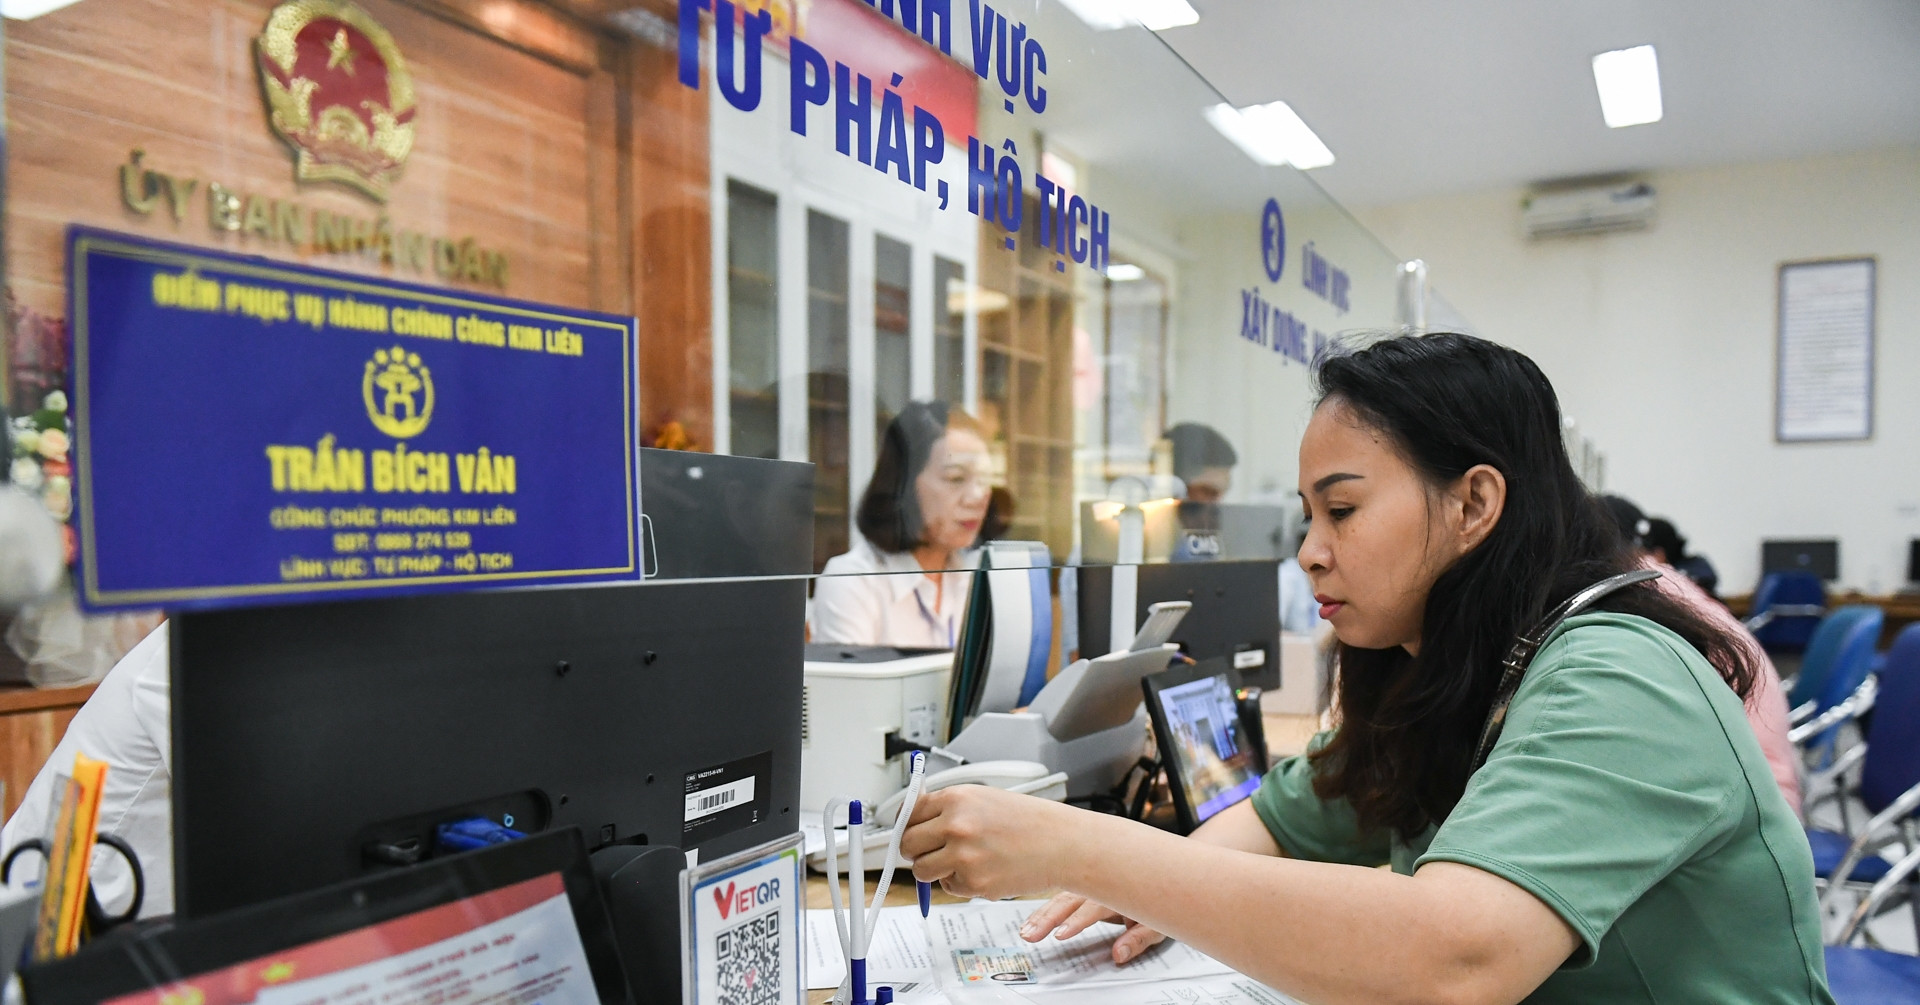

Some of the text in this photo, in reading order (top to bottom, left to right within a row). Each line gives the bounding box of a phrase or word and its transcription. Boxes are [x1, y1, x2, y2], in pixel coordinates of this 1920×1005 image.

[969, 0, 1047, 114] VỰC
[678, 0, 772, 112] TƯ
[790, 36, 949, 210] PHÁP,
[968, 135, 1023, 251] HỘ
[1036, 173, 1110, 274] TỊCH
[208, 181, 302, 245] BAN
[312, 208, 431, 273] NHÂN
[433, 236, 510, 289] DÂN
[225, 282, 290, 325] PHỤC
[294, 293, 326, 331] VỤ
[391, 306, 453, 340] CHÍNH
[456, 314, 506, 347] CÔNG
[508, 324, 542, 351] KIM
[545, 327, 583, 357] LIÊN
[1241, 286, 1270, 346] XÂY
[371, 441, 450, 492] BÍCH
[456, 446, 516, 493] VÂN
[270, 503, 327, 529] CÔNG
[453, 508, 481, 525] KIM
[482, 504, 517, 525] LIÊN
[454, 551, 476, 572] HỘ
[713, 878, 780, 920] VIETQR
